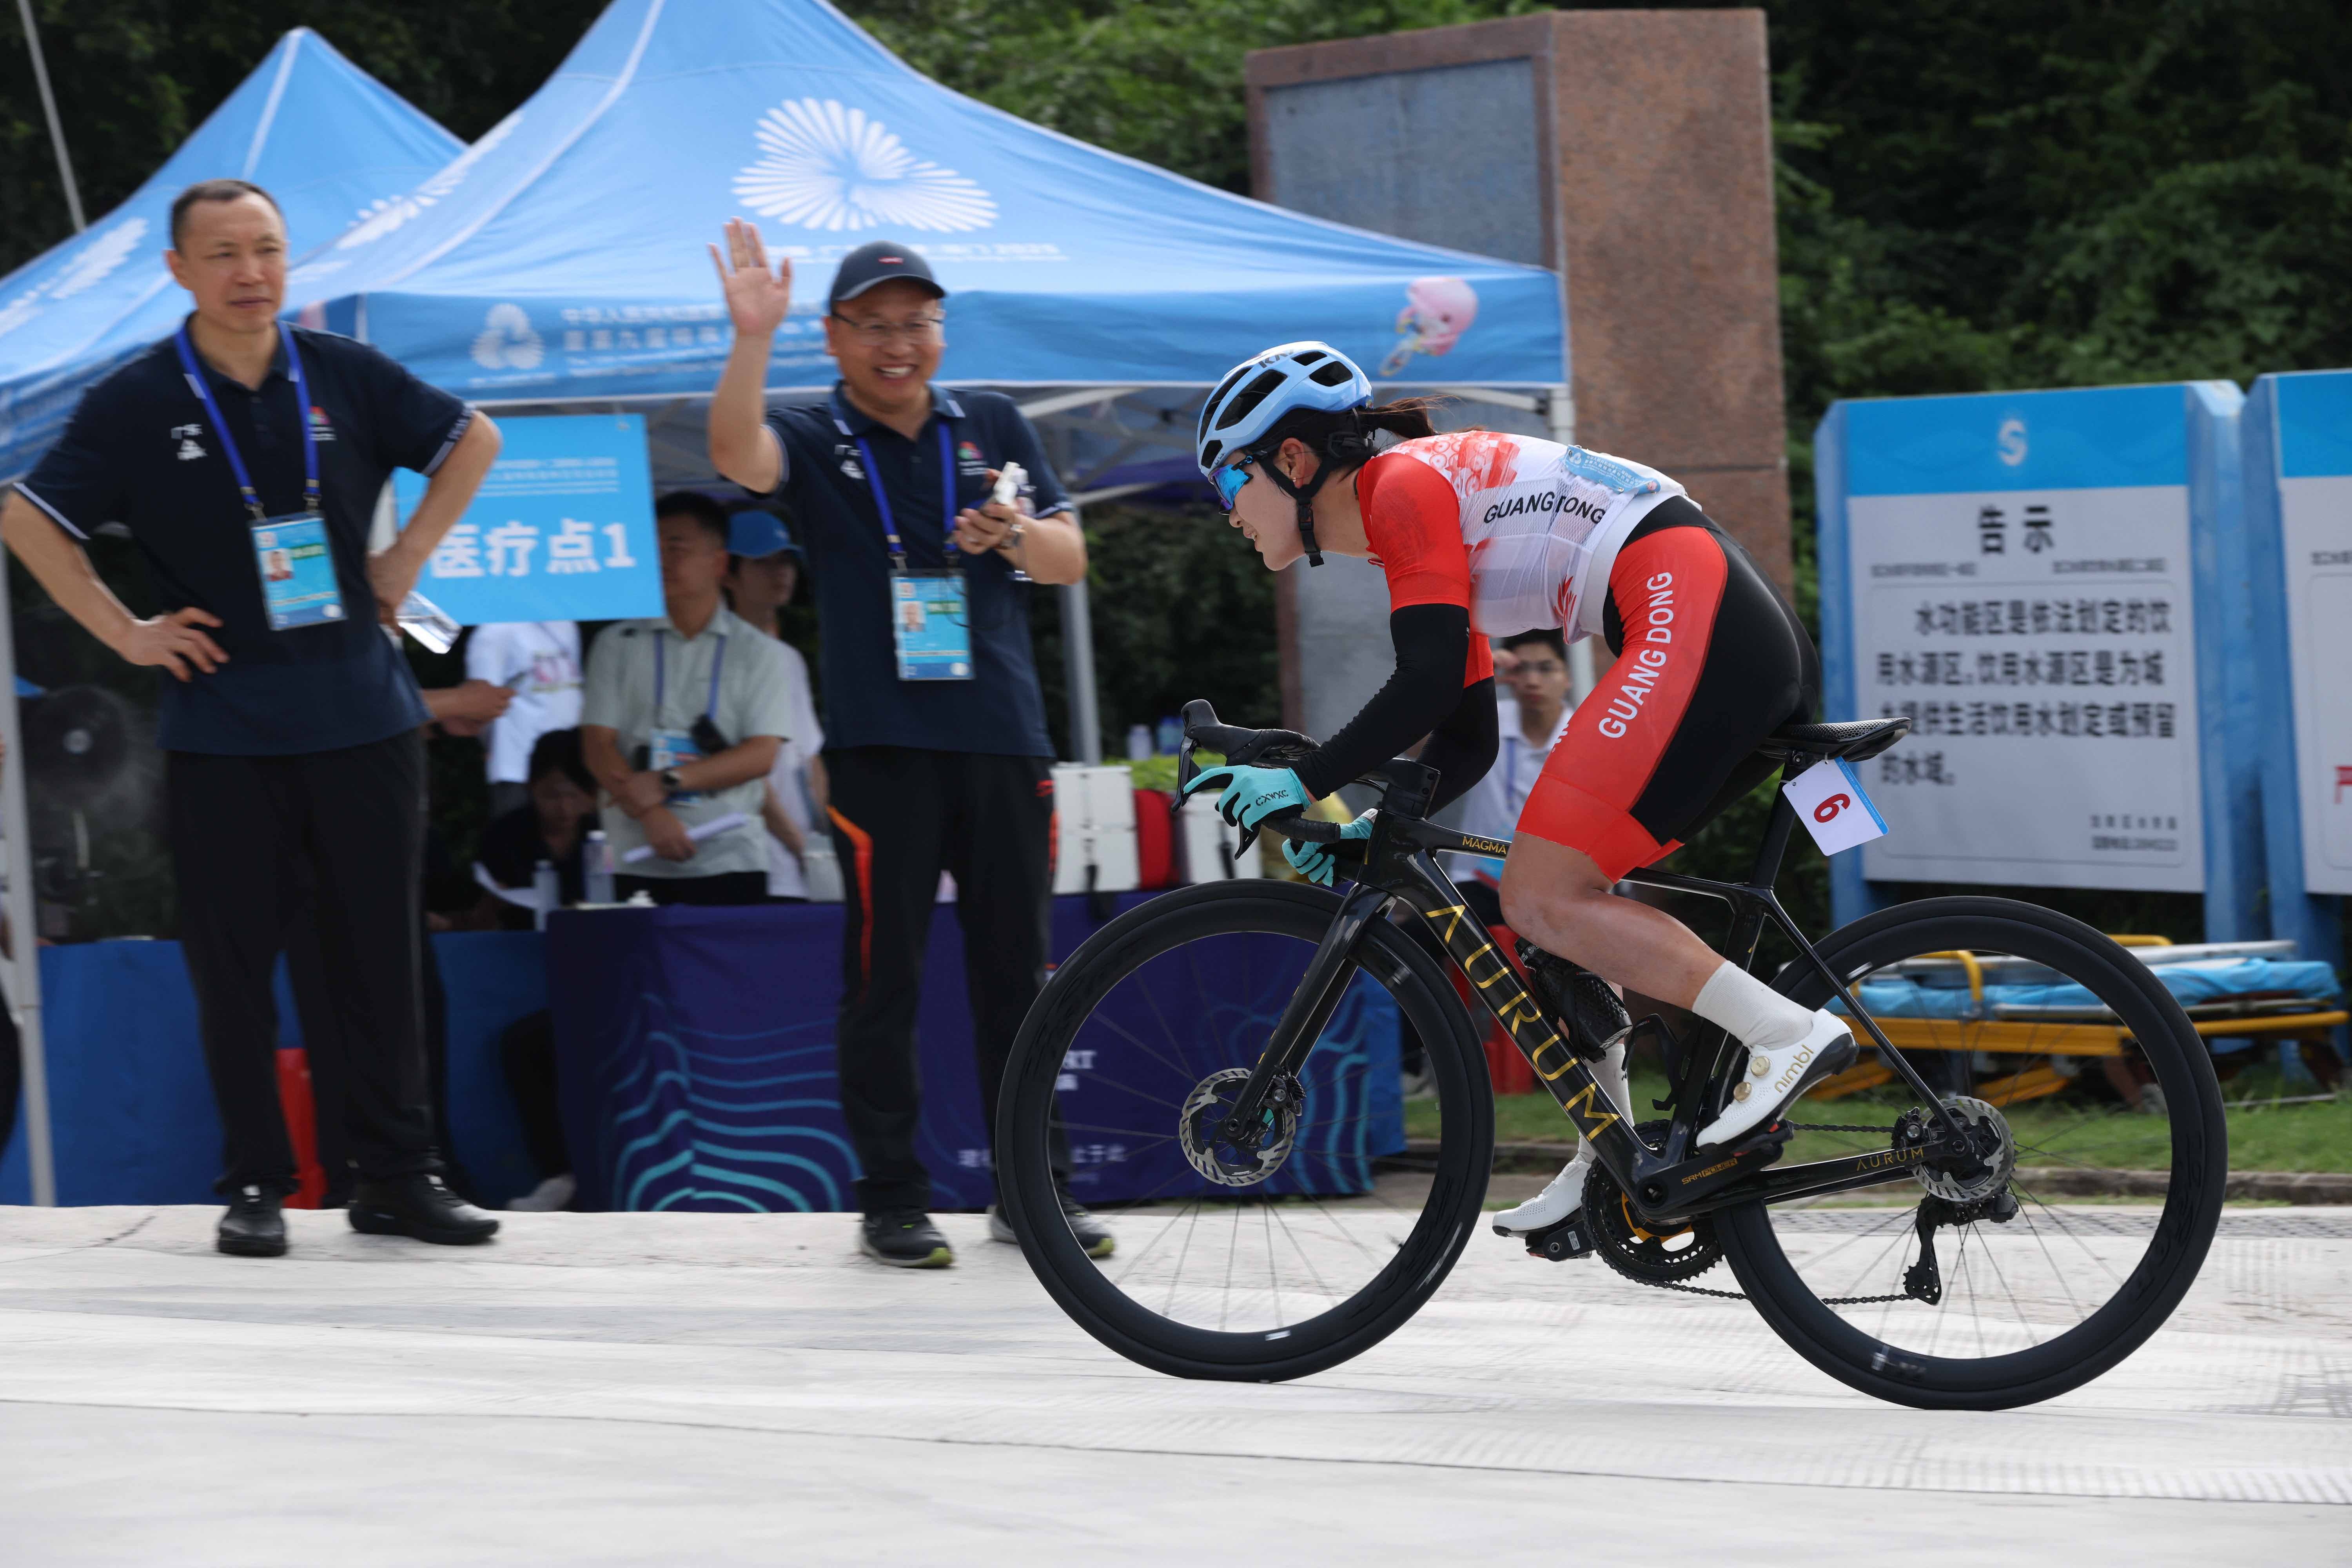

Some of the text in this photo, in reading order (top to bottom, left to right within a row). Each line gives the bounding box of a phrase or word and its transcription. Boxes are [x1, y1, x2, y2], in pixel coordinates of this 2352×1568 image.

[1484, 492, 1555, 523] GUANG
[430, 518, 637, 579] 医疗点1
[1979, 505, 2054, 554] 告示
[1599, 572, 1673, 739] GUANG DONG
[1814, 793, 1851, 823] 6
[1463, 836, 1506, 855] MAGMA
[1425, 904, 1621, 1142] AURUM
[1774, 1045, 1814, 1094] nimbl
[1682, 1158, 1738, 1185] SRM POWER
[1857, 1147, 1924, 1171] AURUM
